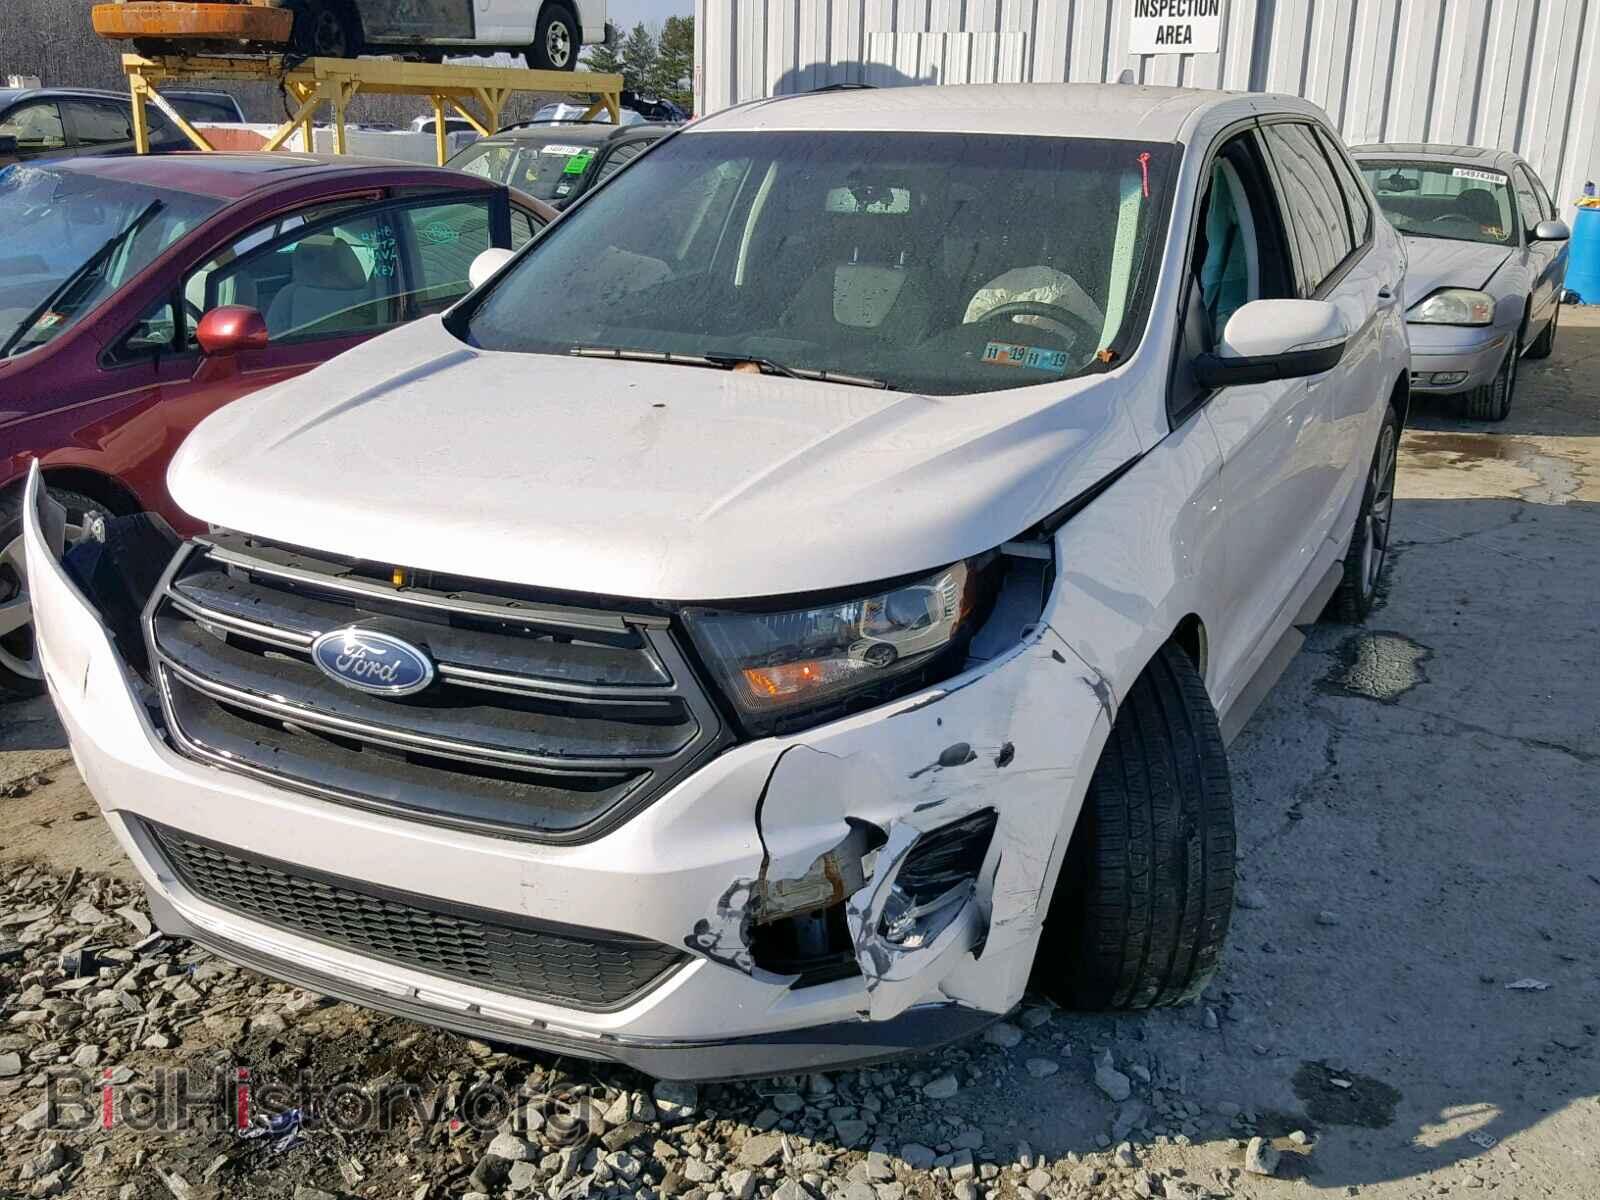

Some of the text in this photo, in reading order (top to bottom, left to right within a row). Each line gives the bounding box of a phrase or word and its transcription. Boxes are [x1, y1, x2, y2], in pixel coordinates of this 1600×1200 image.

[1134, 0, 1219, 17] INSPECTION
[1155, 25, 1192, 44] AREA
[336, 639, 401, 682] Ford
